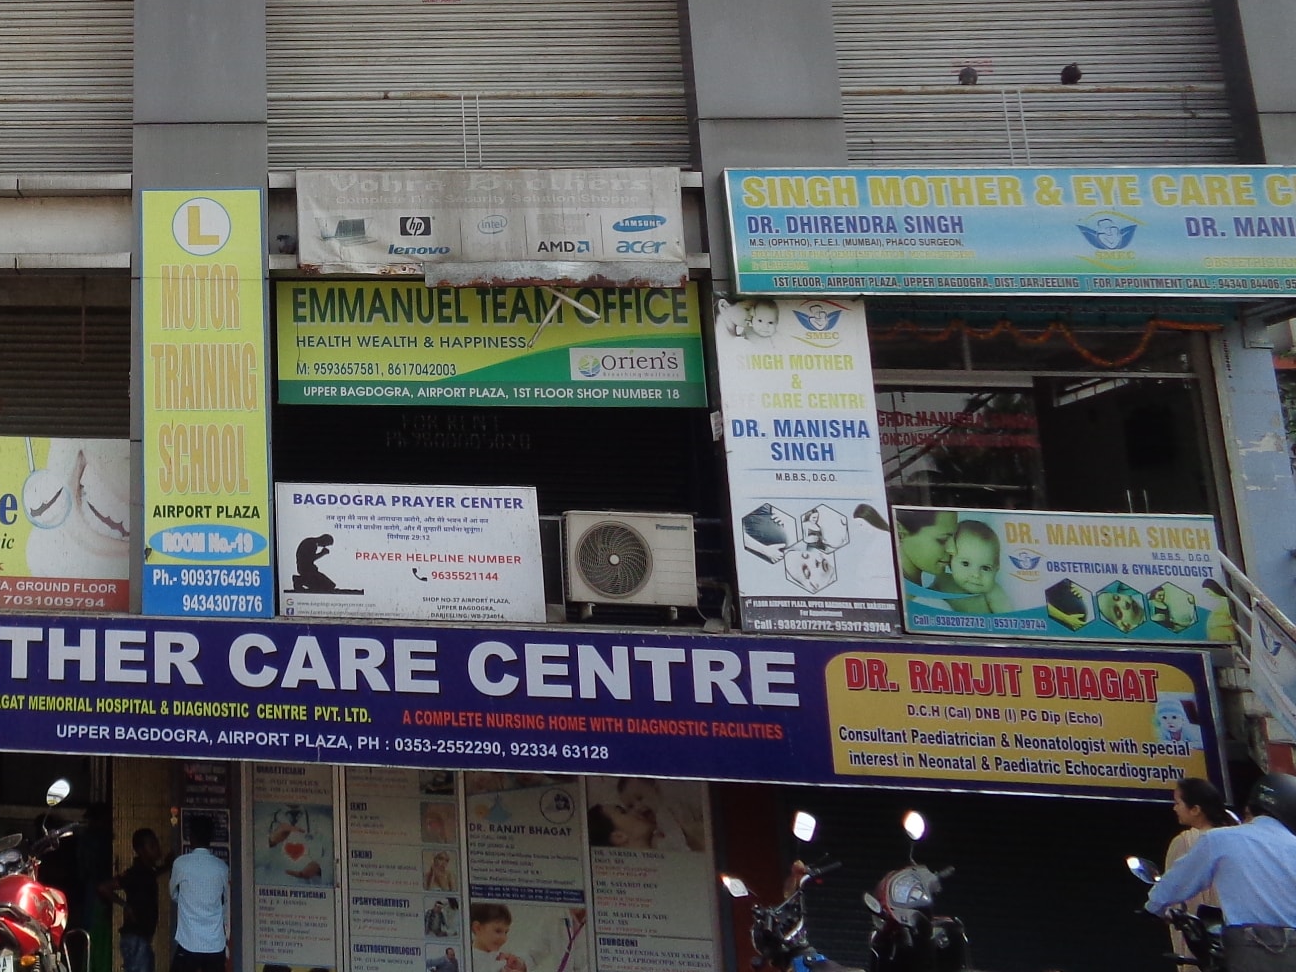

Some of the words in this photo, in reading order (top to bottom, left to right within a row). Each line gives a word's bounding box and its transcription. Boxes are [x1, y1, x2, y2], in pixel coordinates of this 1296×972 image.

[742, 176, 858, 208] SINGH
[868, 176, 1024, 208] MOTHER
[1072, 176, 1142, 207] EYE
[1151, 174, 1257, 207] CARE
[188, 205, 219, 245] L
[786, 216, 898, 234] DHIRENDRA
[904, 215, 964, 234] SINGH
[616, 239, 667, 254] acer
[886, 238, 917, 247] PHACO
[1020, 278, 1079, 288] DARJEELING
[161, 264, 241, 331] MOTOR
[292, 288, 469, 323] EMMANUEL
[574, 288, 688, 325] OFFICE
[296, 336, 352, 348] HEALTH
[357, 336, 418, 348] WEALTH
[806, 332, 839, 340] SMEC
[602, 350, 678, 370] Orien's
[789, 354, 854, 370] MOTHER
[150, 342, 259, 412] TRAINING
[388, 363, 457, 376] 8617042003
[792, 374, 802, 389] &
[304, 386, 337, 397] UPPER
[418, 387, 465, 397] AIRPORT
[534, 388, 573, 399] FLOOR
[577, 388, 609, 399] SHOP
[613, 388, 662, 399] NUMBER
[762, 393, 803, 409] CARE
[774, 420, 870, 438] MANISHA
[158, 423, 250, 495] SCHOOL
[771, 442, 835, 461] SINGH
[813, 473, 837, 482] D.G.O.
[293, 493, 387, 506] BAGDOGRA
[392, 496, 456, 509] PRAYER
[461, 496, 524, 510] CENTER
[153, 505, 212, 518] AIRPORT
[217, 505, 260, 519] PLAZA
[162, 532, 205, 553] ROOM
[1046, 523, 1141, 548] MANISHA
[1147, 526, 1212, 550] SINGH
[356, 552, 402, 561] PRAYER
[406, 553, 464, 563] HELPLINE
[432, 571, 499, 581] 9635521144
[1046, 561, 1118, 575] OBSTETRICIAN
[181, 569, 261, 586] 9093764296
[183, 595, 263, 612] 9434307876
[863, 622, 891, 632] 39744
[936, 617, 985, 628] 9382072712
[228, 633, 440, 693] CARE
[467, 640, 800, 708] CENTRE
[844, 657, 900, 692] DR.
[908, 659, 1024, 698] RANJIT
[1033, 664, 1159, 703] BHAGAT
[28, 696, 92, 712] MEMORIAL
[96, 698, 156, 714] HOSPITAL
[173, 700, 249, 718] DIAGNOSTIC
[256, 704, 307, 721] CENTRE
[486, 712, 546, 729] NURSING
[627, 718, 709, 736] DIAGNOSTIC
[712, 722, 784, 740] FACILITIES
[974, 707, 1000, 721] DNB
[56, 724, 110, 740] UPPER
[217, 730, 290, 747] AIRPORT
[838, 726, 908, 744] Consultant
[910, 729, 997, 749] Paediatrician
[1014, 734, 1106, 757] Neonatologist
[918, 753, 977, 771] Neonatal
[994, 756, 1061, 776] Paediatric
[529, 826, 572, 837] BHAGAT
